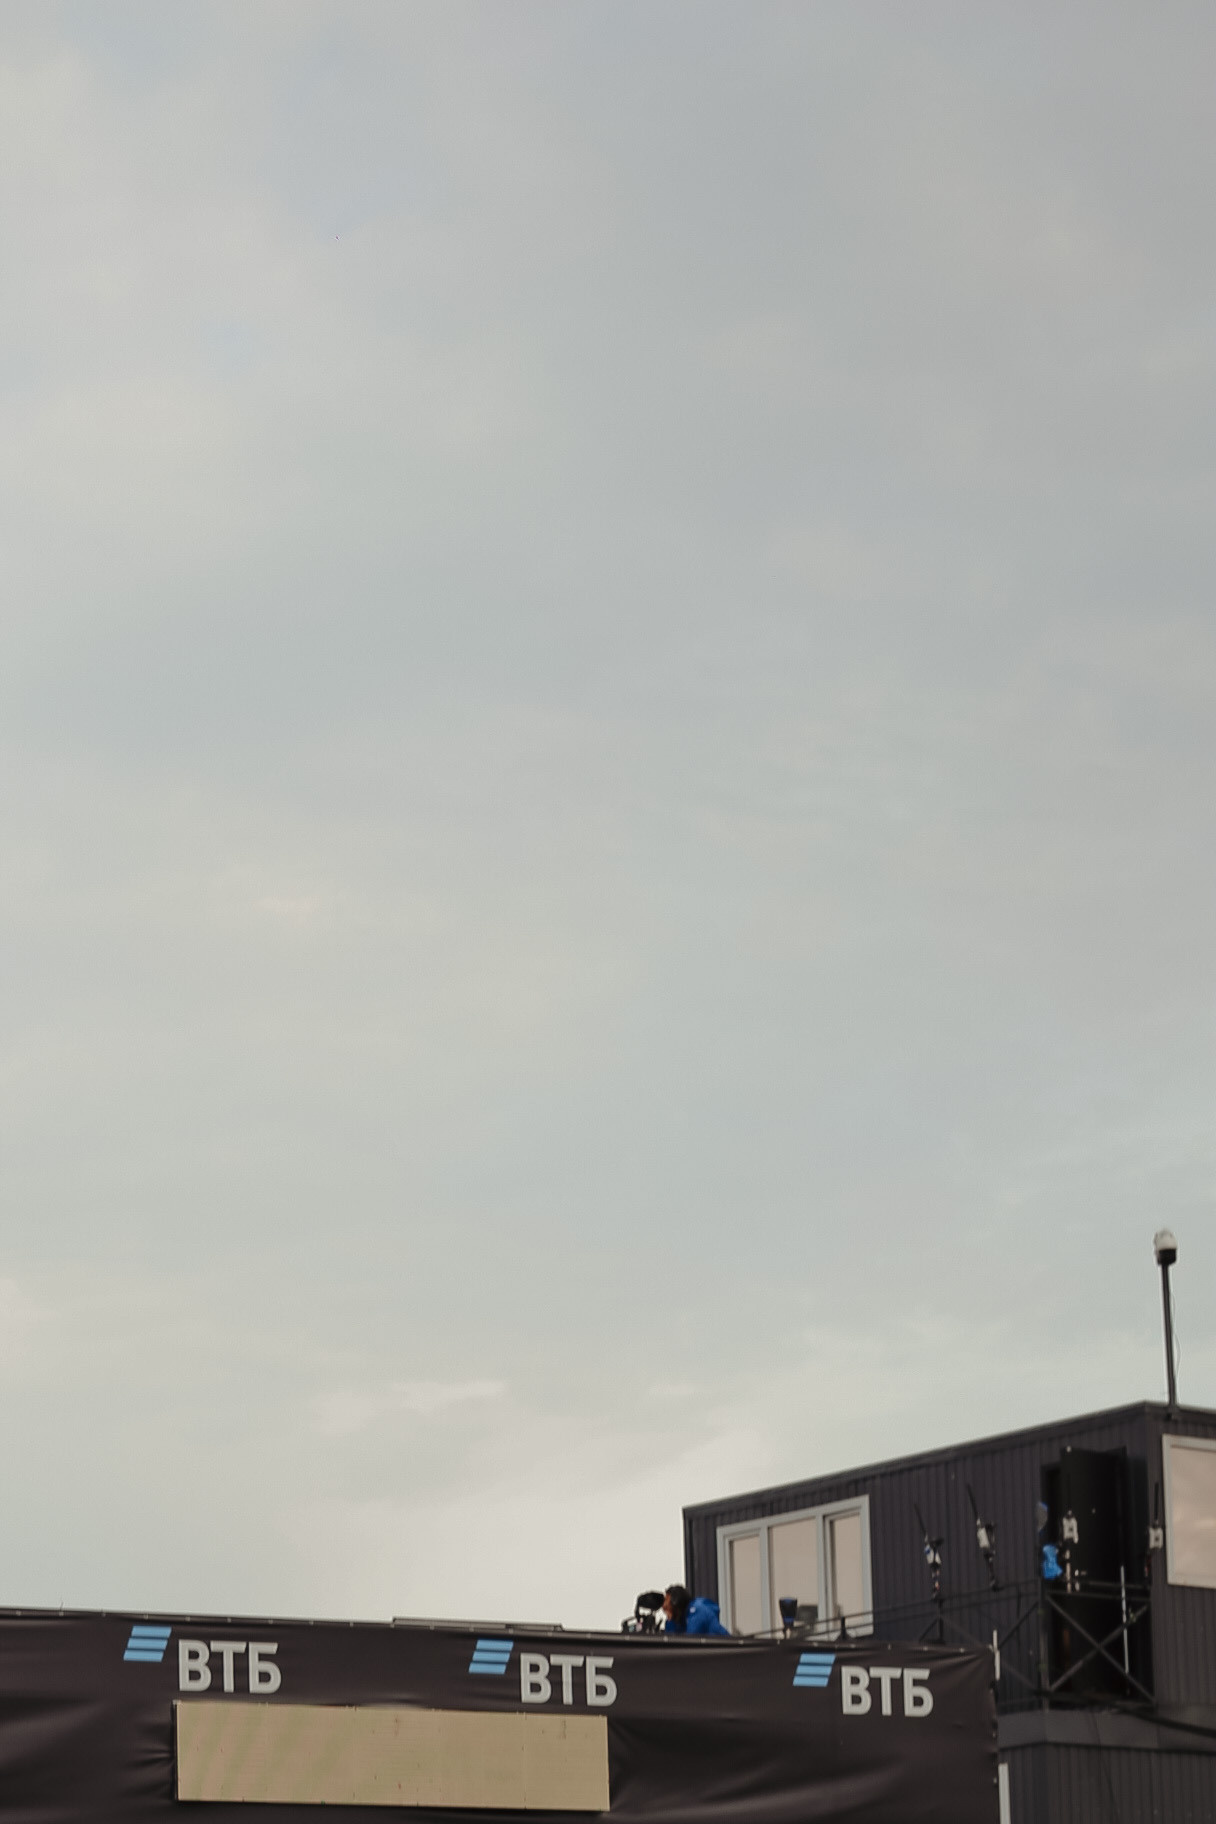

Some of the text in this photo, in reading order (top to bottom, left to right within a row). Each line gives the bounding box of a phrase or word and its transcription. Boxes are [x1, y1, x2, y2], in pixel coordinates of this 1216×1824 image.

[178, 1639, 282, 1694] ВТБ
[520, 1652, 618, 1707] ВТБ
[841, 1665, 934, 1718] ВТБ
